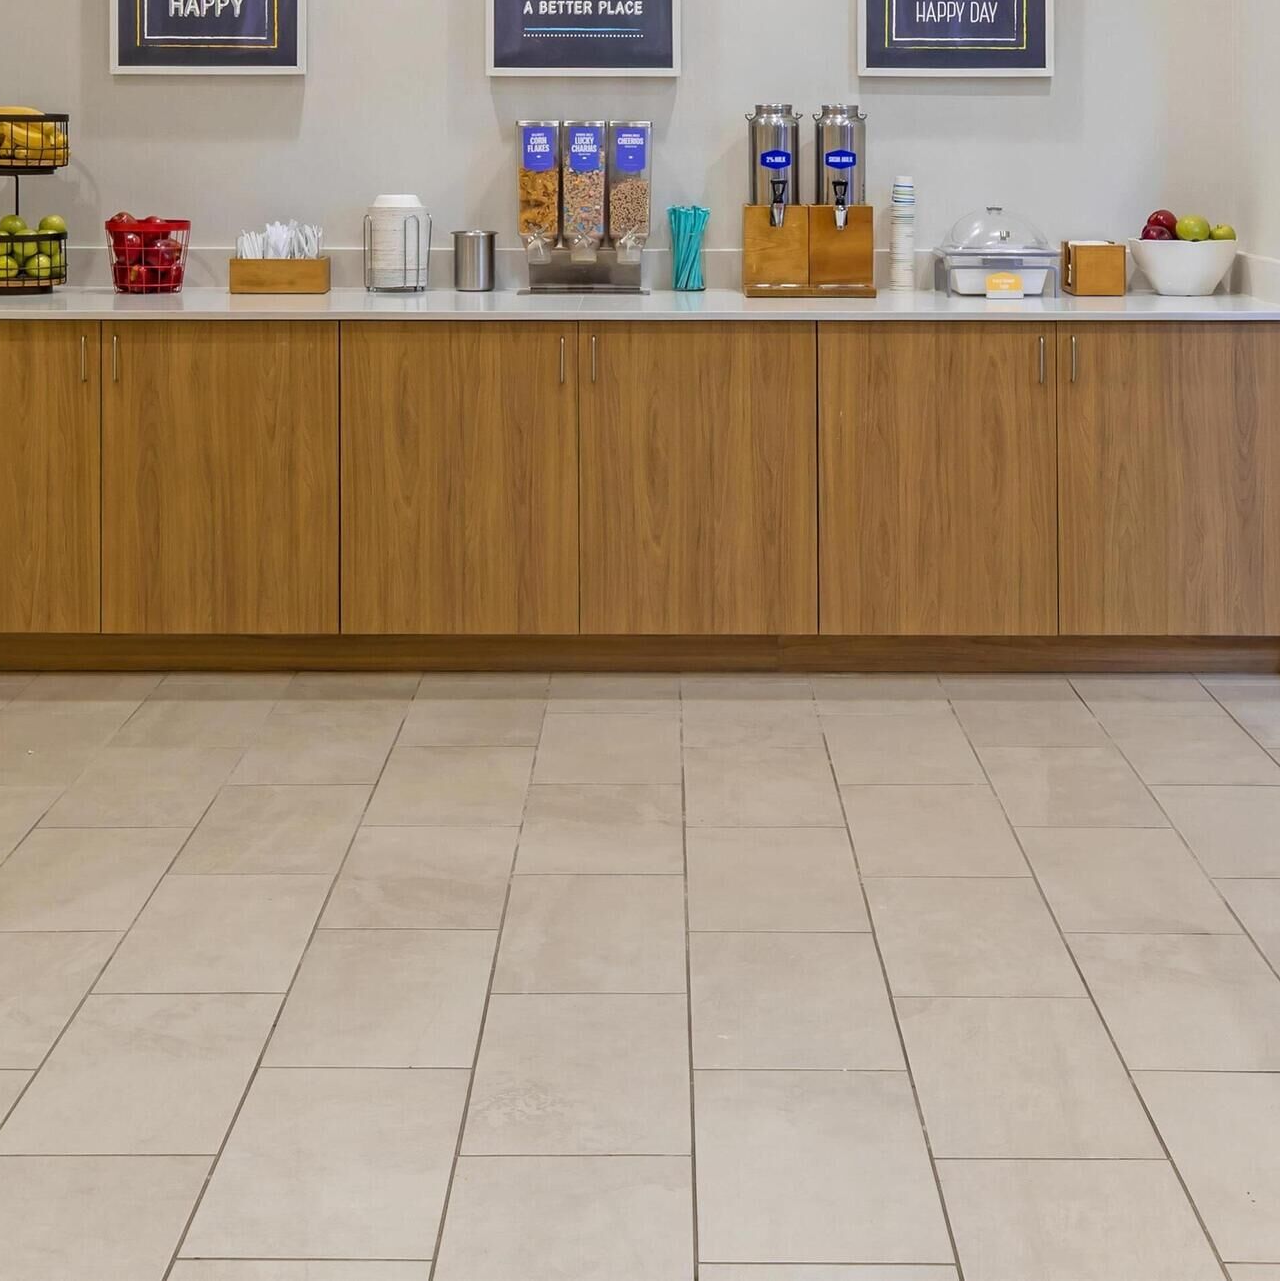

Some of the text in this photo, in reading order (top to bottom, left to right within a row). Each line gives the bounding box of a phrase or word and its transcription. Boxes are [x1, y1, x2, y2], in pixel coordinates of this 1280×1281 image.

[523, 0, 643, 16] A BETTER PLACE
[916, 1, 998, 23] HAPPY DAY
[529, 136, 548, 145] CORN
[574, 136, 595, 145] LUCKY
[617, 137, 644, 146] CHEERIOS
[527, 144, 550, 153] FLAKES
[571, 144, 598, 153] CHARMS
